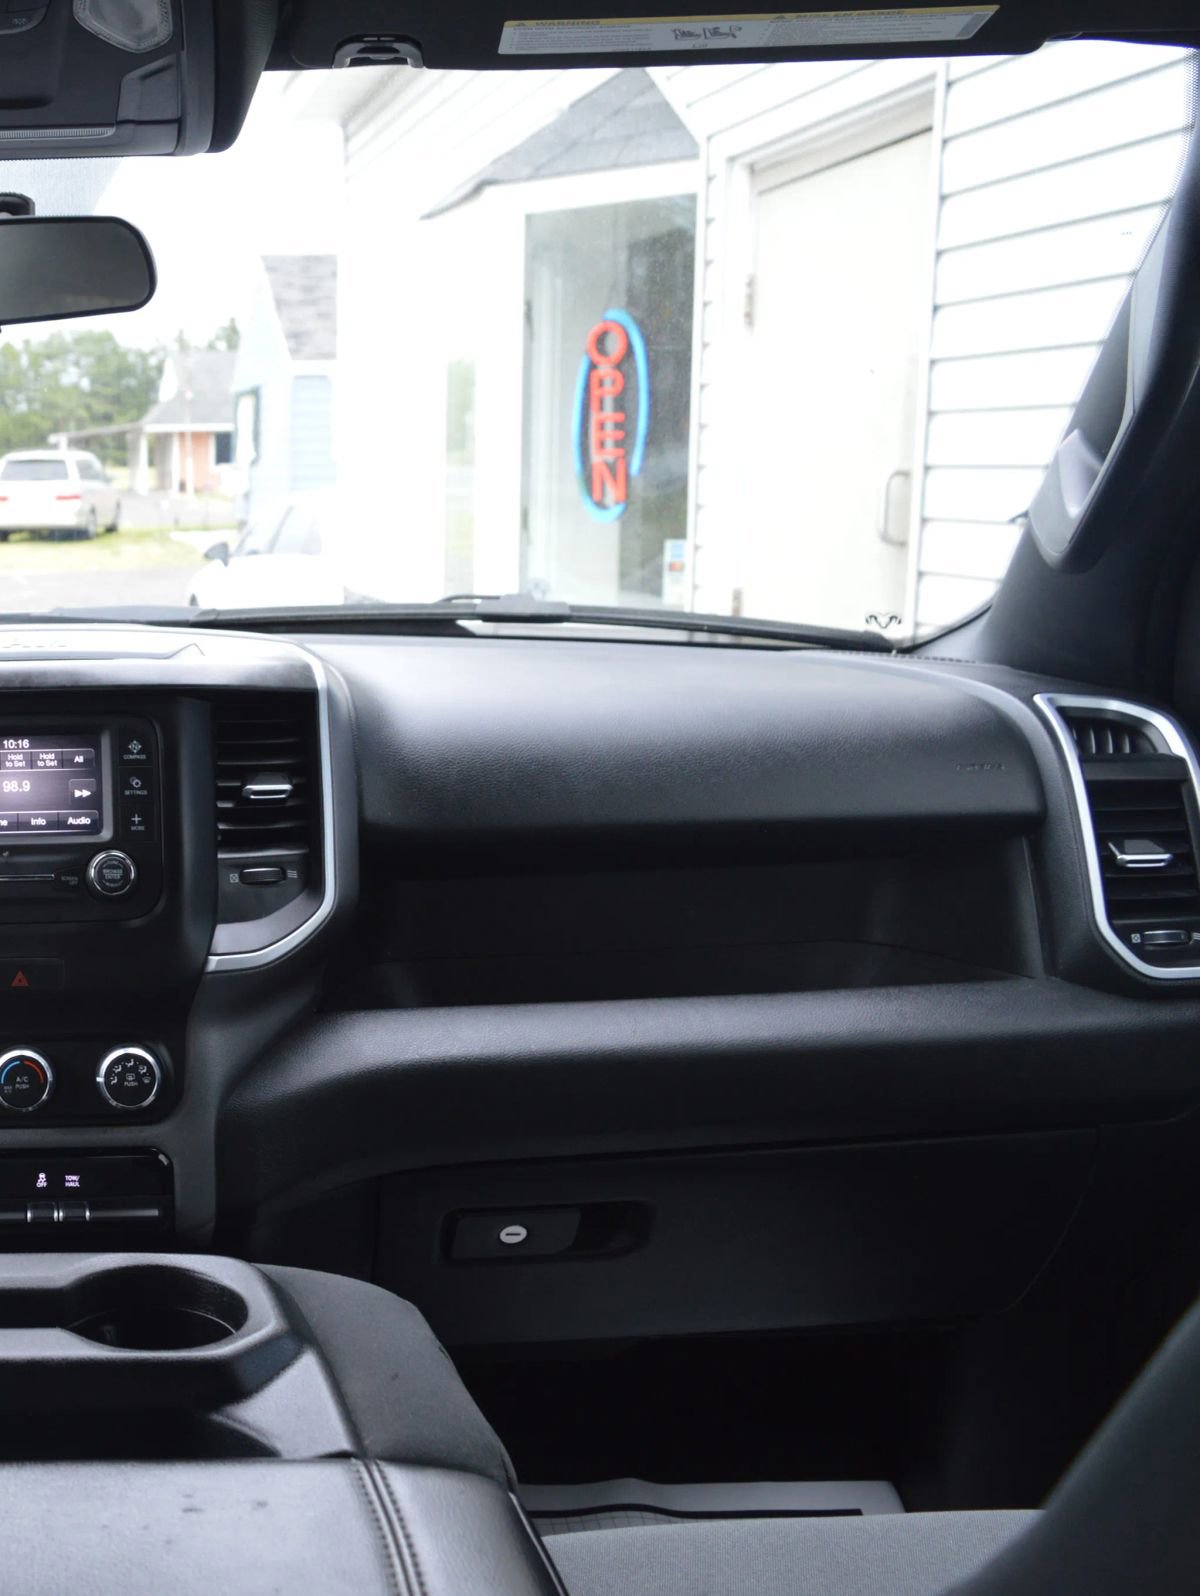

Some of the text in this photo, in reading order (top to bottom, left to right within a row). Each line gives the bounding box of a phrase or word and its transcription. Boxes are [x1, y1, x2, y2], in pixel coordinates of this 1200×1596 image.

[586, 320, 629, 503] OPEN
[3, 739, 30, 749] 10:16
[2, 780, 31, 792] 98.9
[31, 817, 47, 825] Info
[67, 816, 91, 825] Audio
